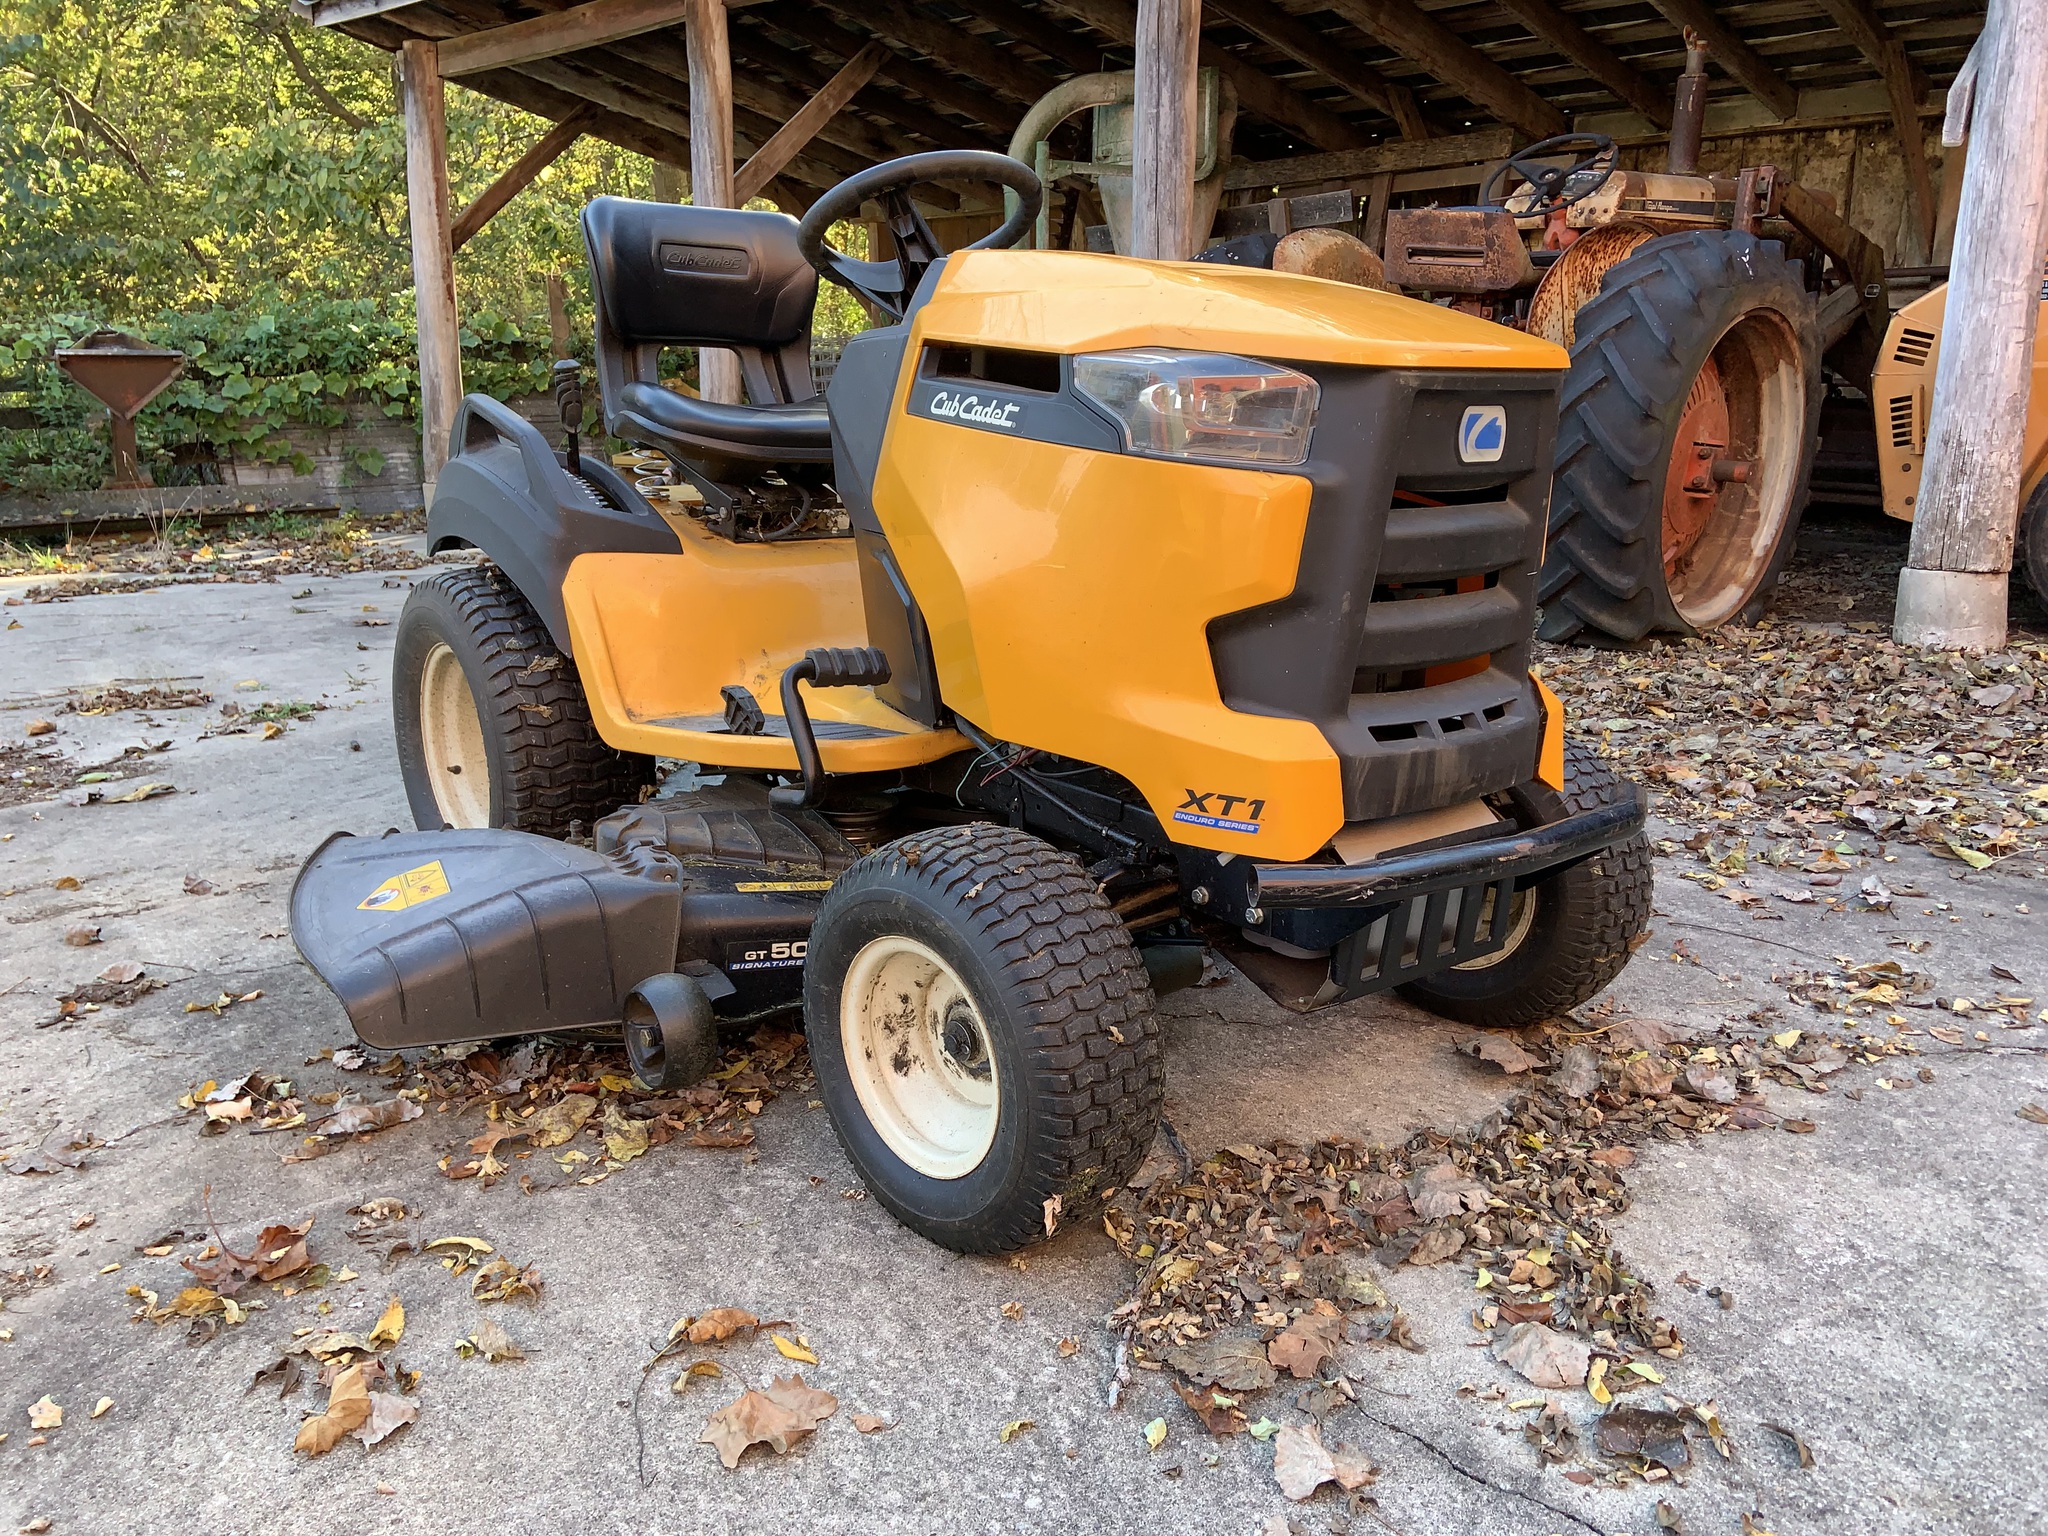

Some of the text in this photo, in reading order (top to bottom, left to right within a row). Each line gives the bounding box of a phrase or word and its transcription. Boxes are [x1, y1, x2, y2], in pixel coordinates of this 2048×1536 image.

[930, 391, 1020, 428] Cub Cadet
[1177, 787, 1266, 821] XT1
[1174, 812, 1256, 832] ENDURO SERIES
[744, 941, 808, 961] GT 50
[731, 959, 805, 971] SIGNATURE
